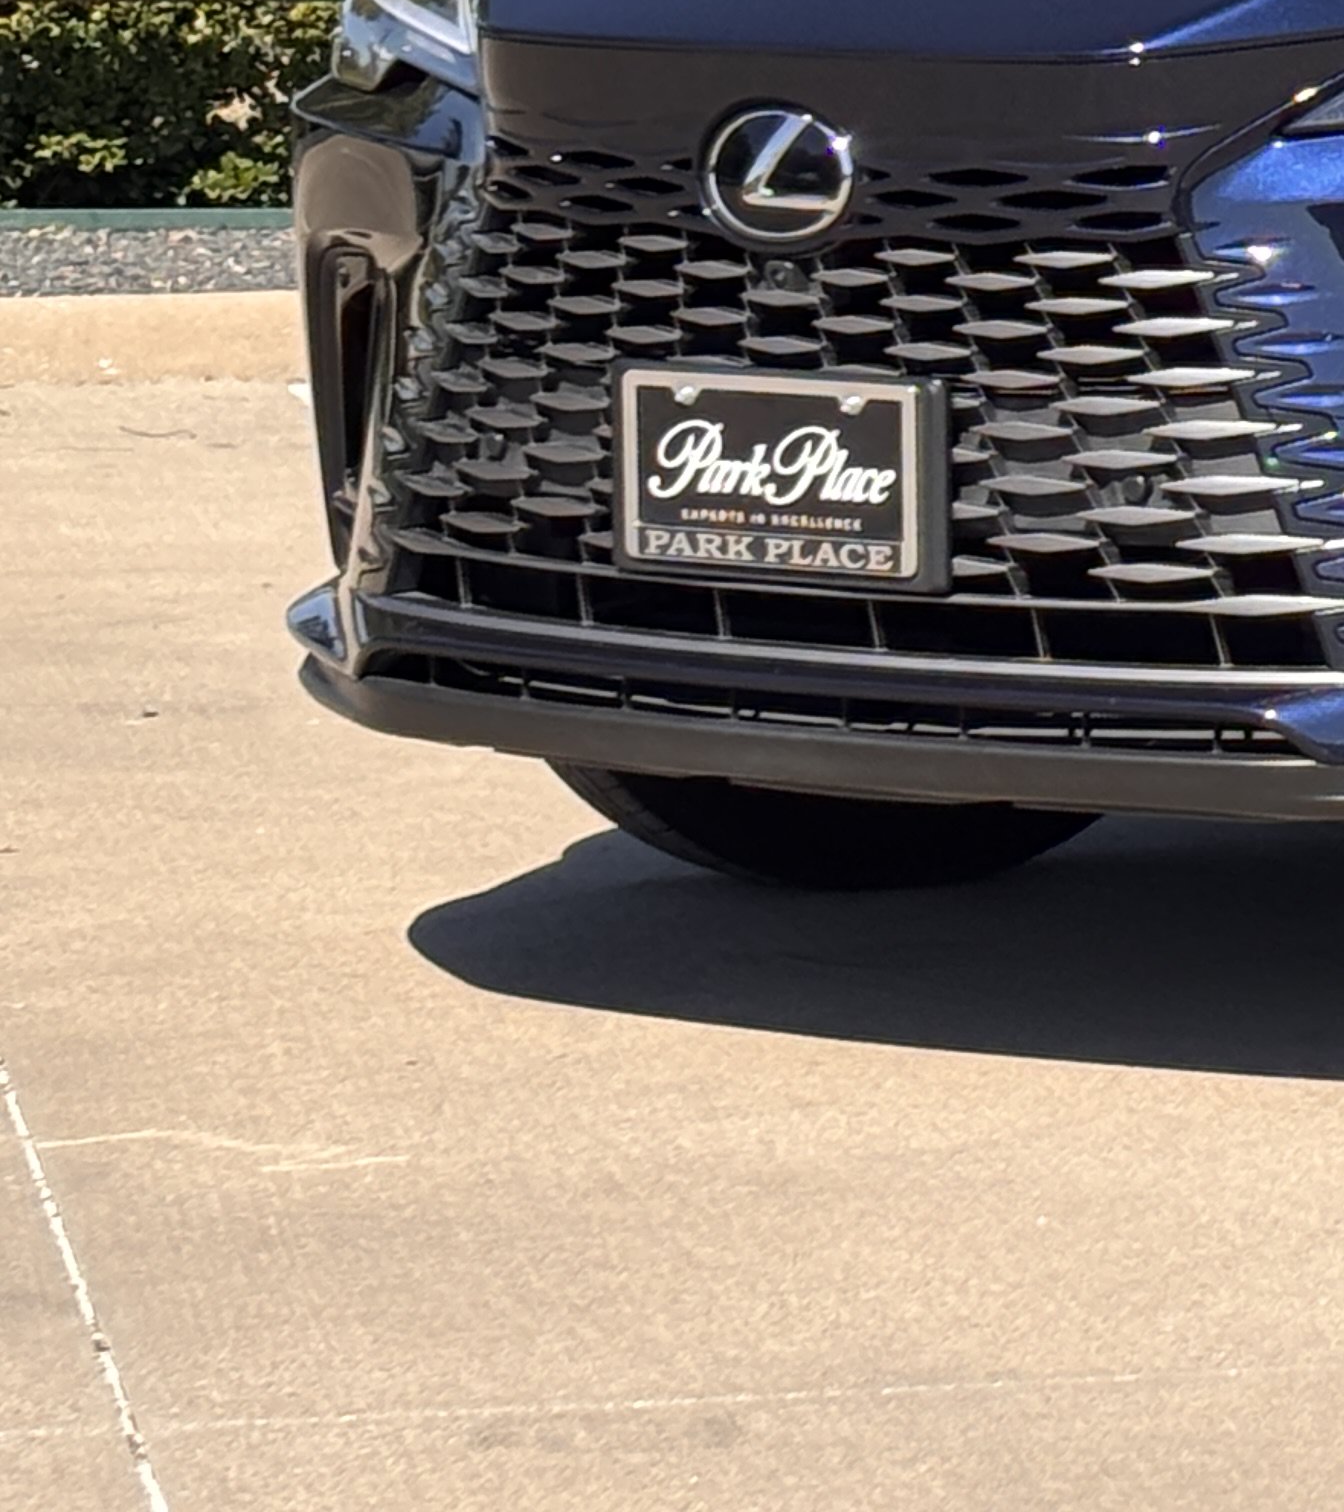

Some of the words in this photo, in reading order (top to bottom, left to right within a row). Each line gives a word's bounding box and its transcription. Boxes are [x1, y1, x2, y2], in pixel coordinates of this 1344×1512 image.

[648, 419, 770, 498] Park
[765, 426, 896, 505] Place
[644, 529, 755, 561] PARK
[765, 537, 894, 571] PLACE
